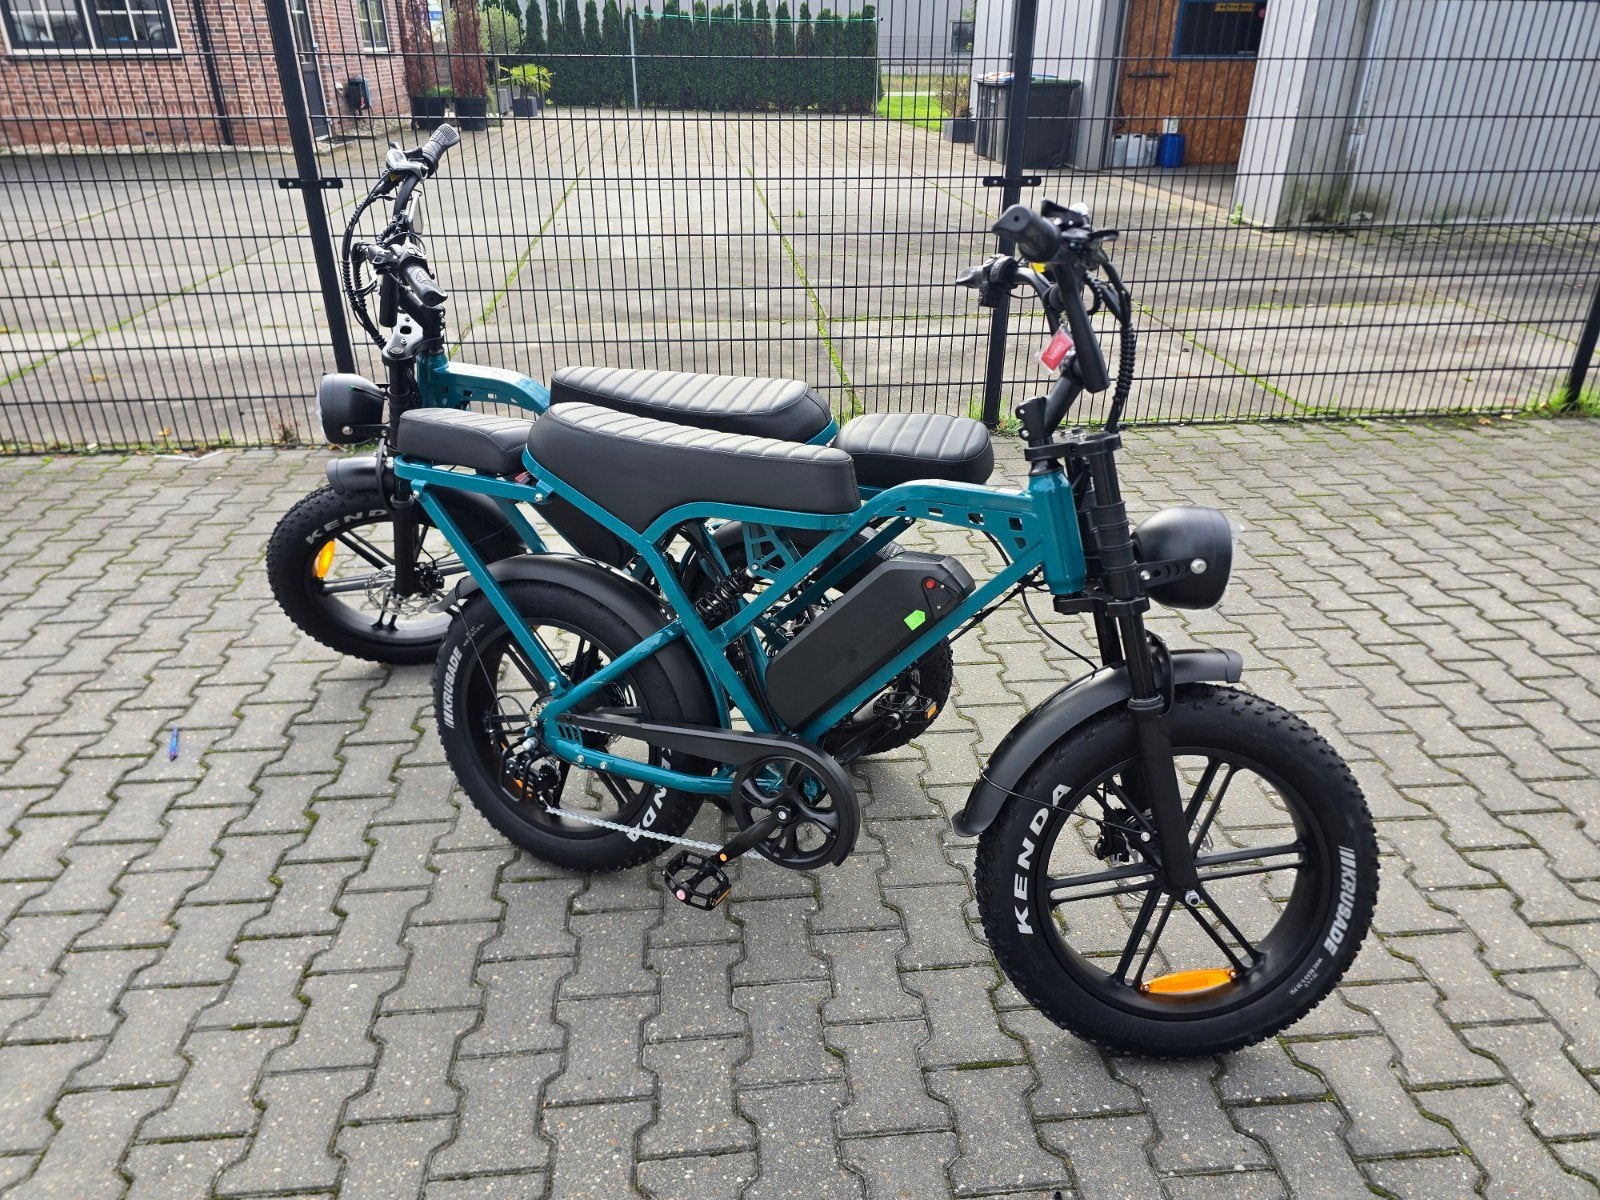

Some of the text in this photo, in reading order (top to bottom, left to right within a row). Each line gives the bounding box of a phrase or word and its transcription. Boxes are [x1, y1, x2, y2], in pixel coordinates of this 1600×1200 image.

[305, 509, 388, 545] KEND
[443, 645, 463, 714] KRUSADE
[1014, 783, 1072, 935] KENDA
[1323, 864, 1357, 957] KRUSADE
